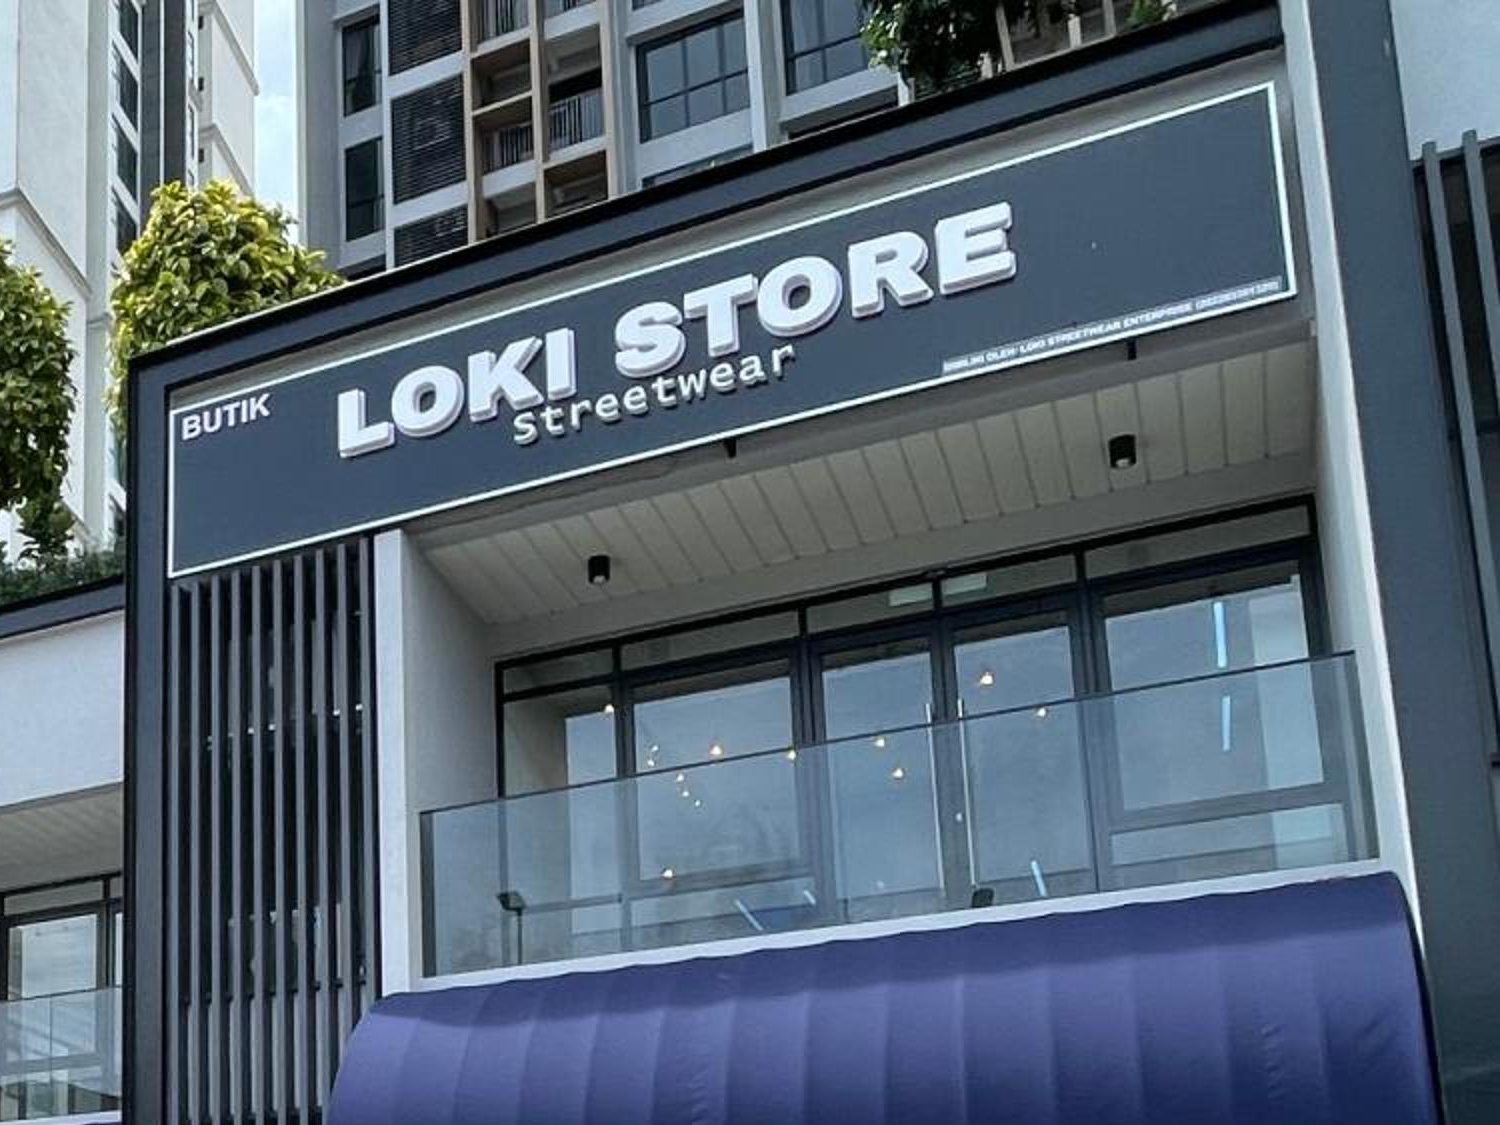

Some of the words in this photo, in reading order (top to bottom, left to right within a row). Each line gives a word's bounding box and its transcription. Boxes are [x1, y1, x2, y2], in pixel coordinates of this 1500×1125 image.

[338, 328, 576, 458] LOKI
[615, 202, 1017, 379] STORE
[1048, 321, 1121, 347] STREETWEAR
[181, 394, 271, 440] BUTIK
[513, 344, 796, 445] Streetwear
